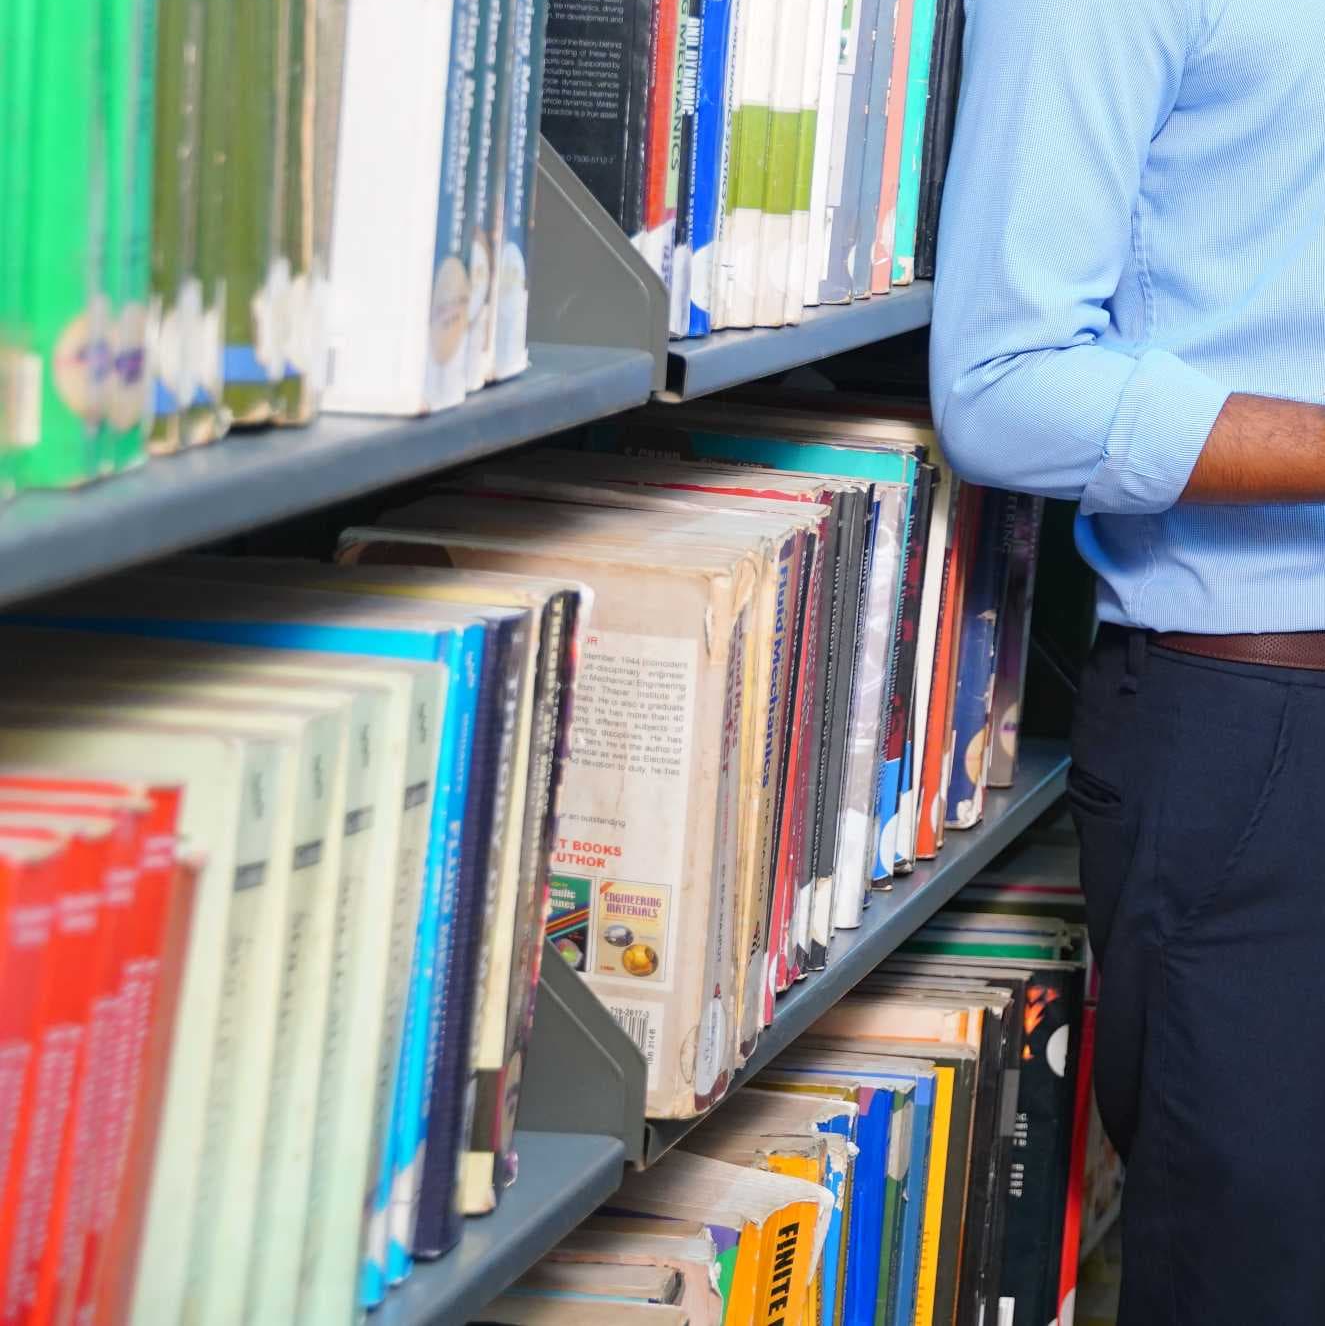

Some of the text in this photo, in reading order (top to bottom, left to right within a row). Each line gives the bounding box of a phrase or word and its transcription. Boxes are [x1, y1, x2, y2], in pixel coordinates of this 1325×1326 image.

[669, 22, 688, 174] MECHANICS
[761, 564, 790, 790] Fluid Mechanics
[572, 840, 622, 857] BOOKS
[603, 891, 662, 909] ENGINEERING
[606, 903, 659, 918] MATERIALS
[768, 1222, 799, 1317] FINITE
